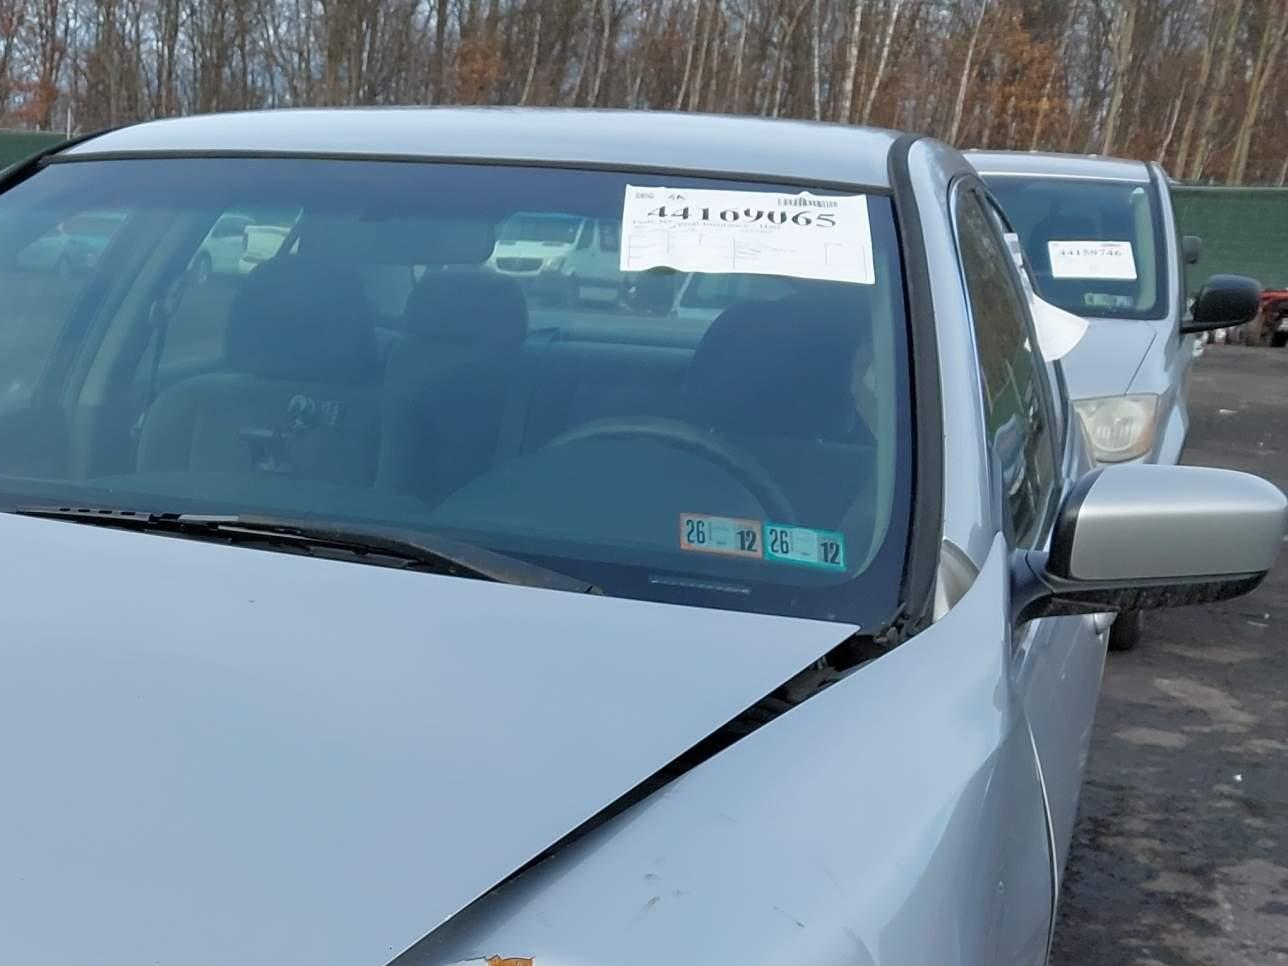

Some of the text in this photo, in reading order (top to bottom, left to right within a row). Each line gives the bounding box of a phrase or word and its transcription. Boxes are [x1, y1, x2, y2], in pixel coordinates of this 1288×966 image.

[685, 518, 758, 553] 26 12
[768, 527, 841, 565] 26 12
